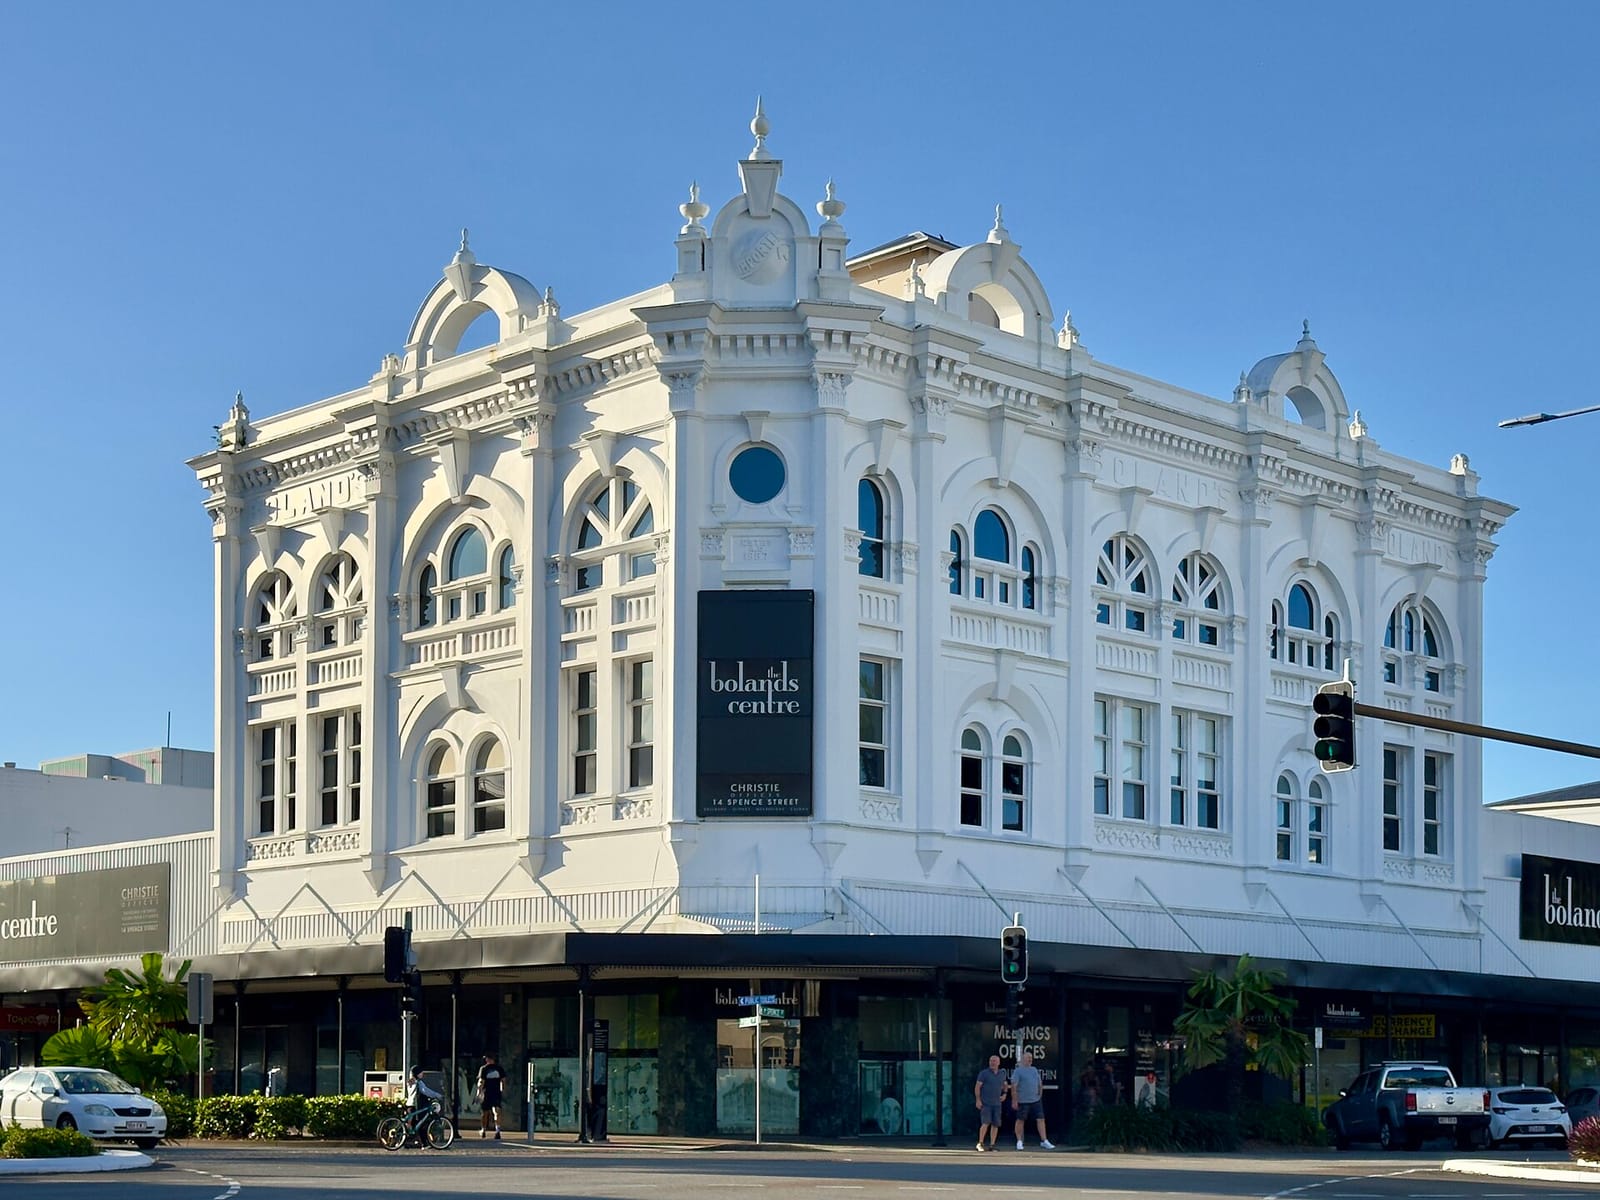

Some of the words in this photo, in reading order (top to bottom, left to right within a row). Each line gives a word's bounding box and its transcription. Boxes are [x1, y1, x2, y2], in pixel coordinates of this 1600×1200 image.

[709, 660, 800, 693] bolands
[728, 692, 801, 715] centre
[730, 783, 781, 792] CHRISTIE
[712, 798, 723, 806] 14
[727, 798, 763, 806] SPENCE
[767, 798, 799, 806] STREET
[121, 885, 160, 901] CHRISTIE
[1, 899, 58, 940] centre
